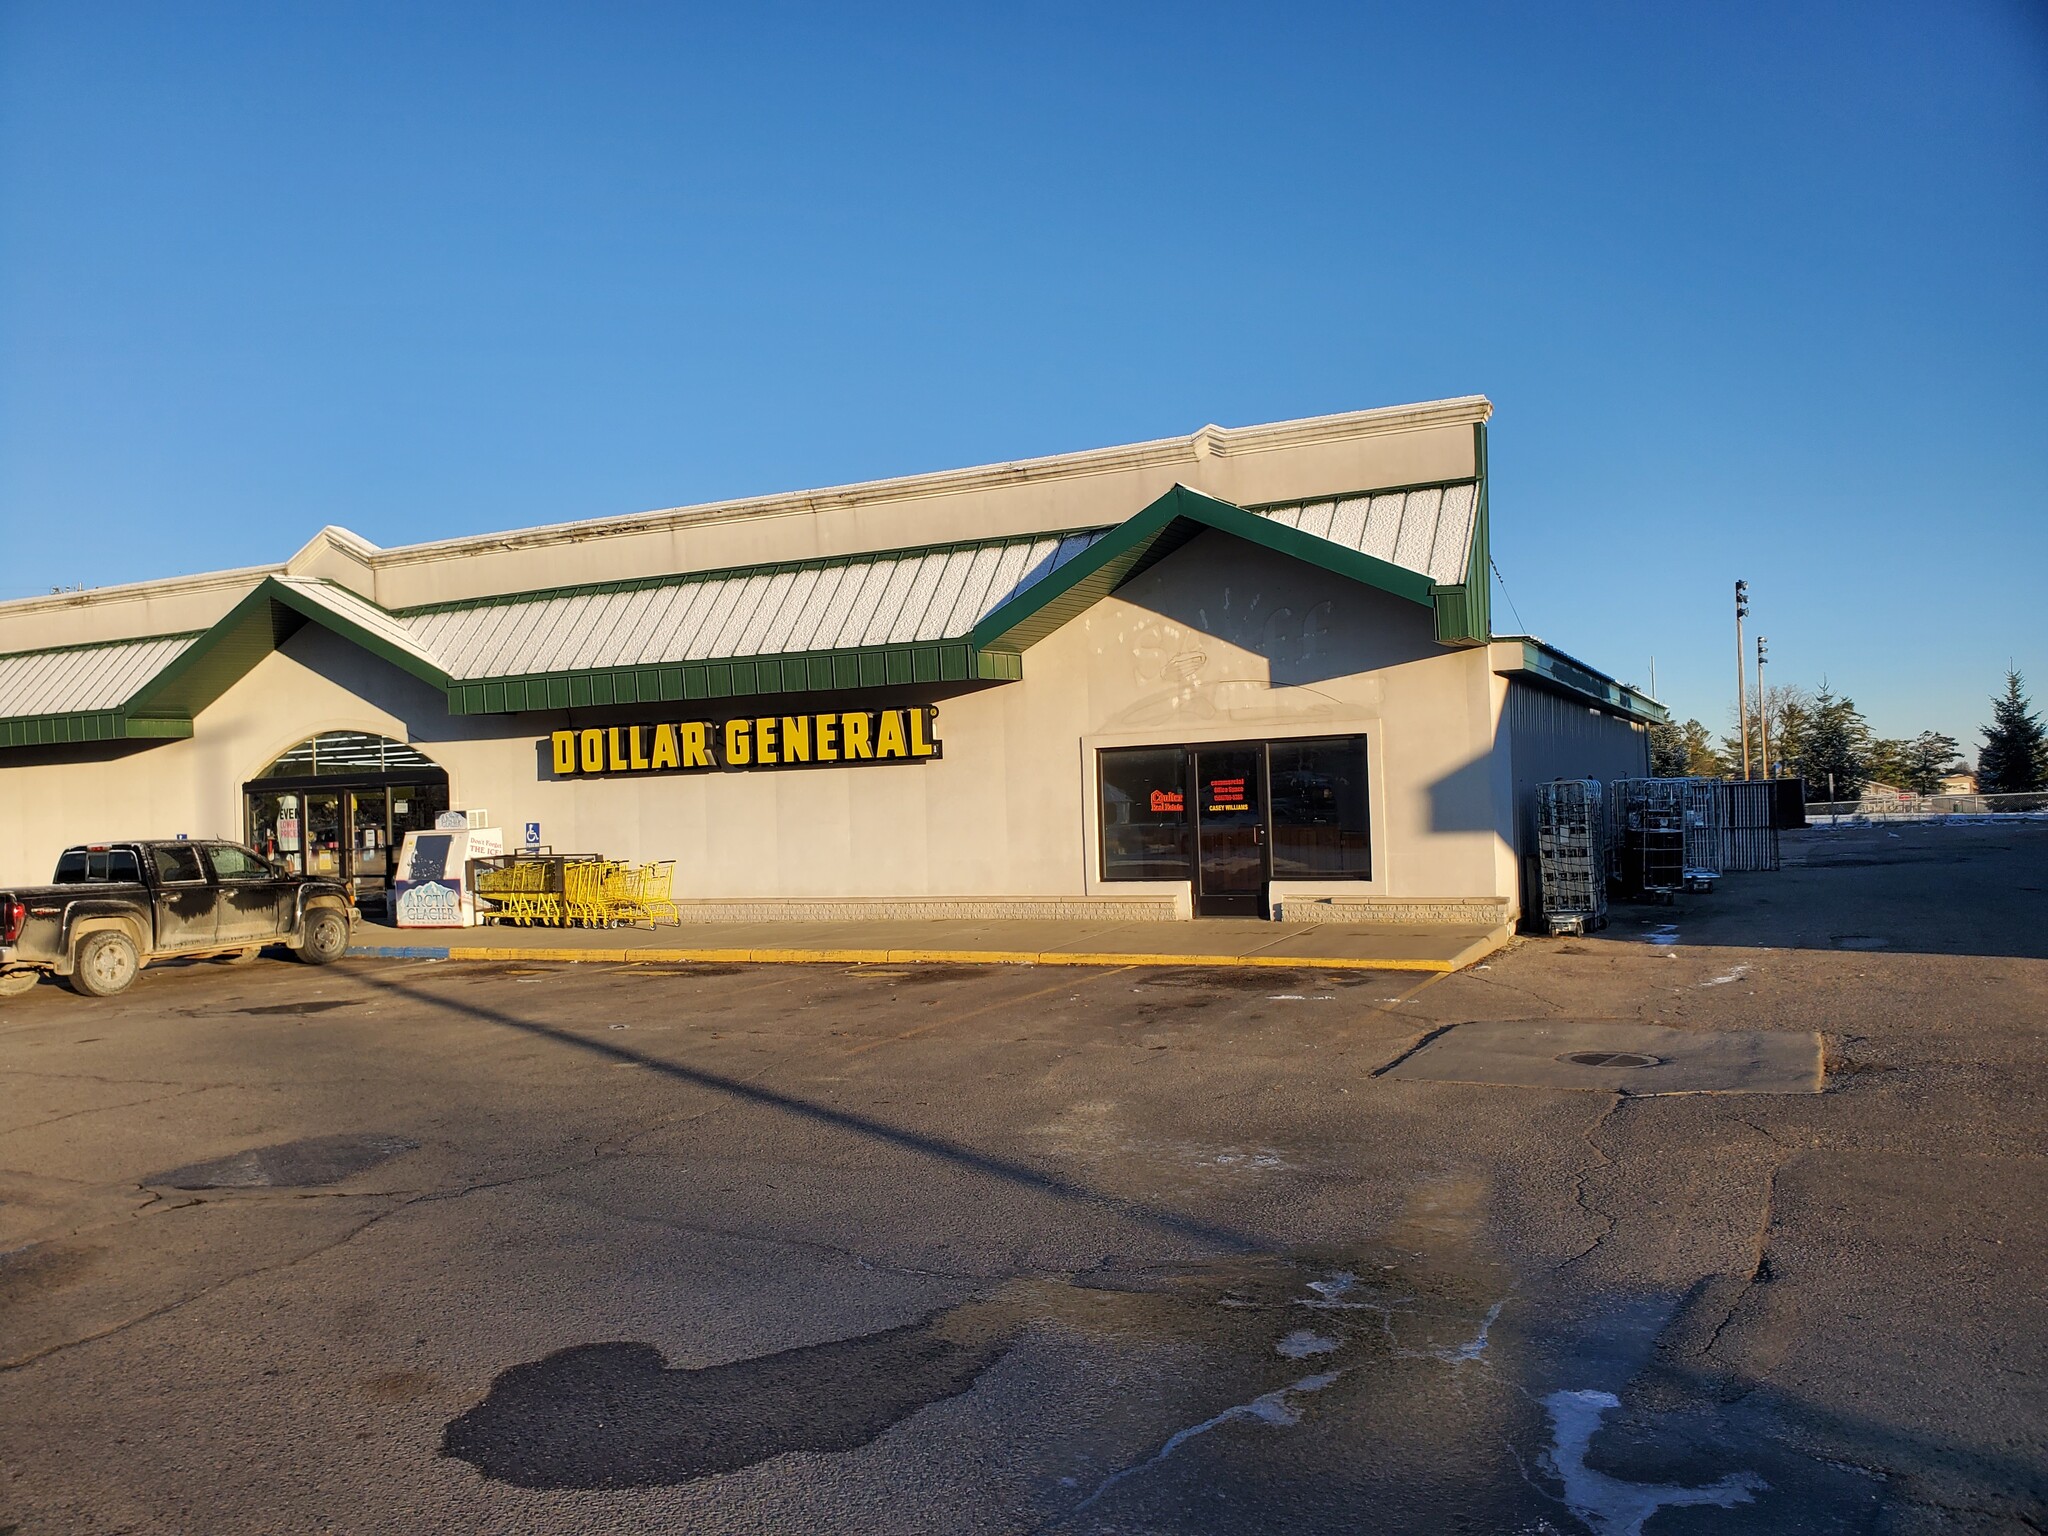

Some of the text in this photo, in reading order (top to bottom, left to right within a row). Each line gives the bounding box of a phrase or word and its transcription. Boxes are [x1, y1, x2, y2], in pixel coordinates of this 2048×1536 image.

[551, 707, 933, 774] DOLLAR GENERAL
[470, 837, 502, 849] Don't Forget
[470, 845, 485, 854] THE
[406, 890, 456, 907] ARCTIC
[407, 908, 456, 920] GLACIER
